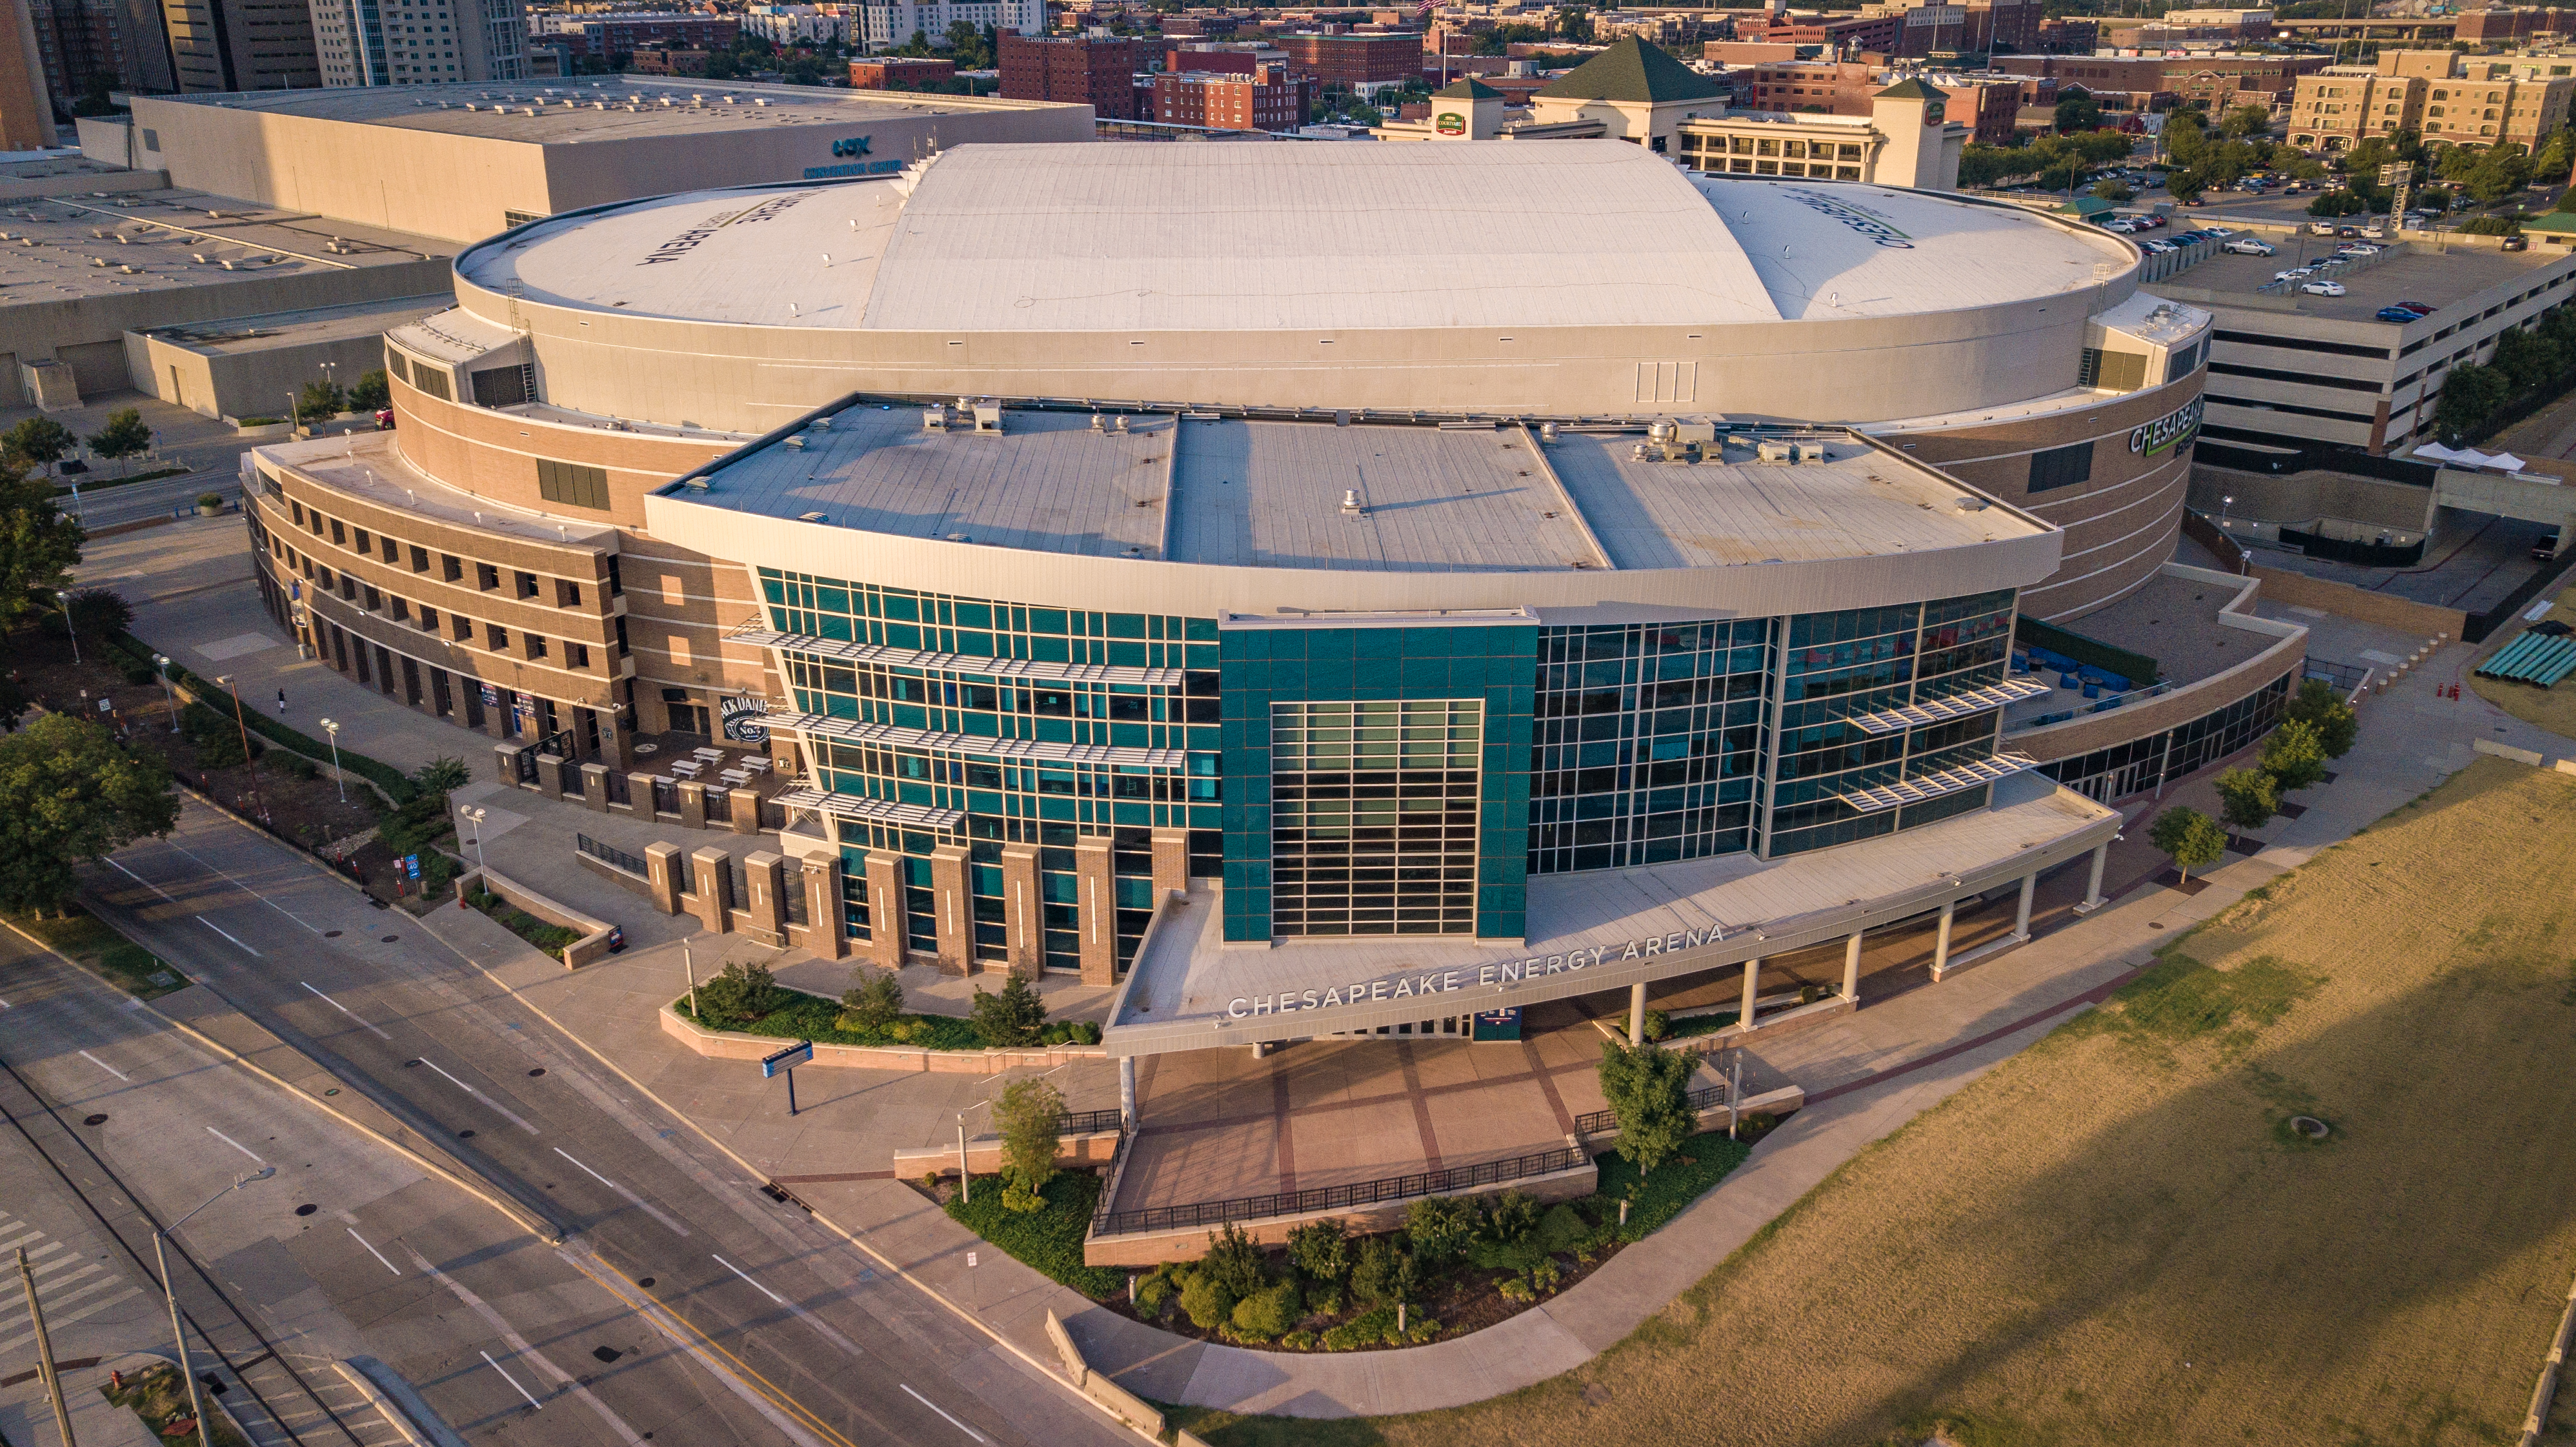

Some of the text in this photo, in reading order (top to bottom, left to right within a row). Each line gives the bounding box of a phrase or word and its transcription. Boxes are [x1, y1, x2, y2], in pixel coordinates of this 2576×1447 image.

[832, 135, 871, 159] COX
[803, 159, 903, 179] CONVENTION CENTER
[635, 228, 719, 266] ARENA
[1228, 924, 1724, 1018] CHESAPEAKE ENERGY ARENA
